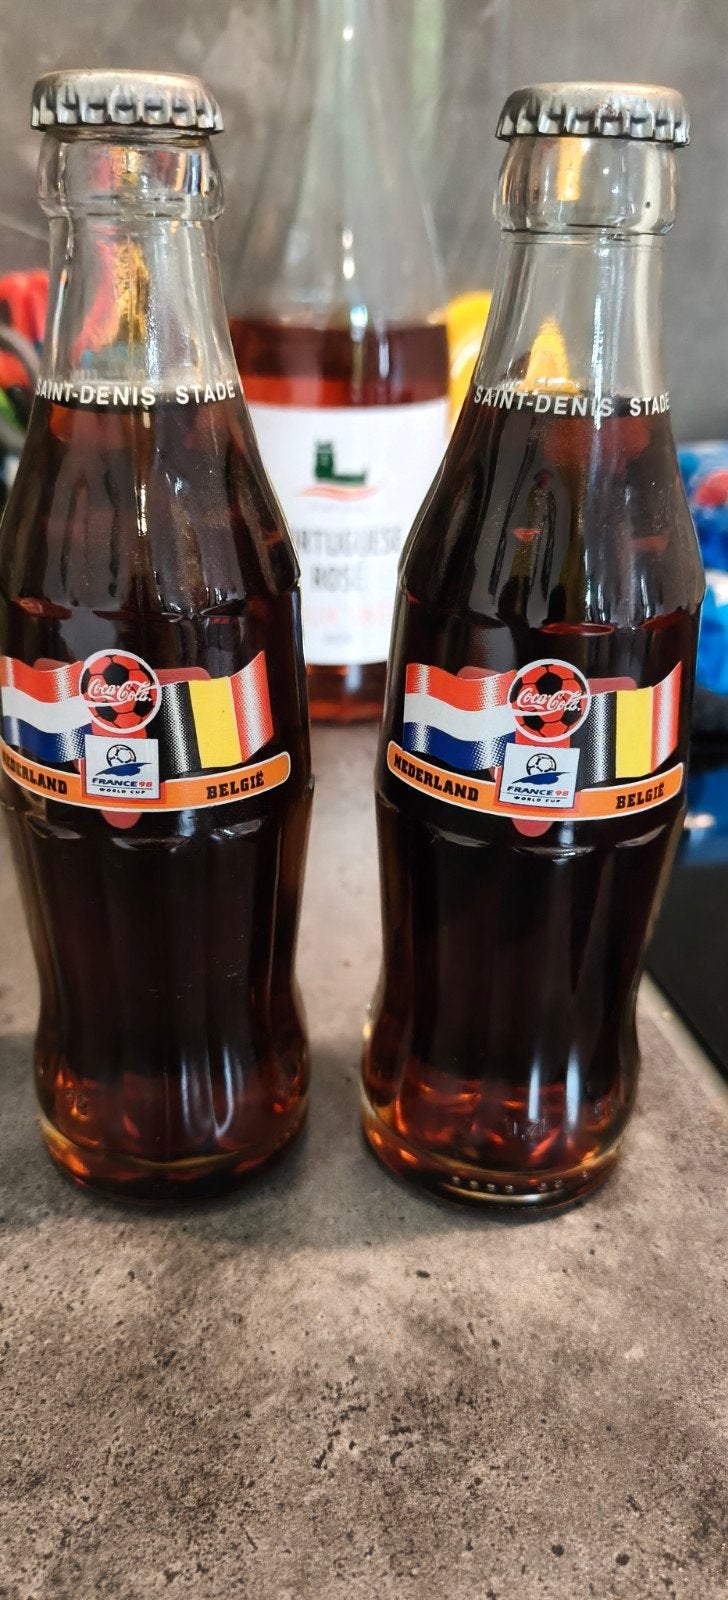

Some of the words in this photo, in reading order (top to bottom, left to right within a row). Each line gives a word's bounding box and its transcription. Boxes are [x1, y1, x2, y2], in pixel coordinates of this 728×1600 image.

[36, 378, 156, 406] SAINT-DENIS
[175, 380, 236, 405] STADE
[474, 385, 613, 417] SAINT-DENIS
[630, 391, 671, 417] STADE
[92, 777, 138, 788] FRANCE
[206, 770, 265, 800] BELGIË
[393, 753, 480, 802] NEDERLAND
[506, 785, 554, 796] FRANCE
[513, 795, 542, 803] WORLD
[615, 782, 665, 809] BELGIË
